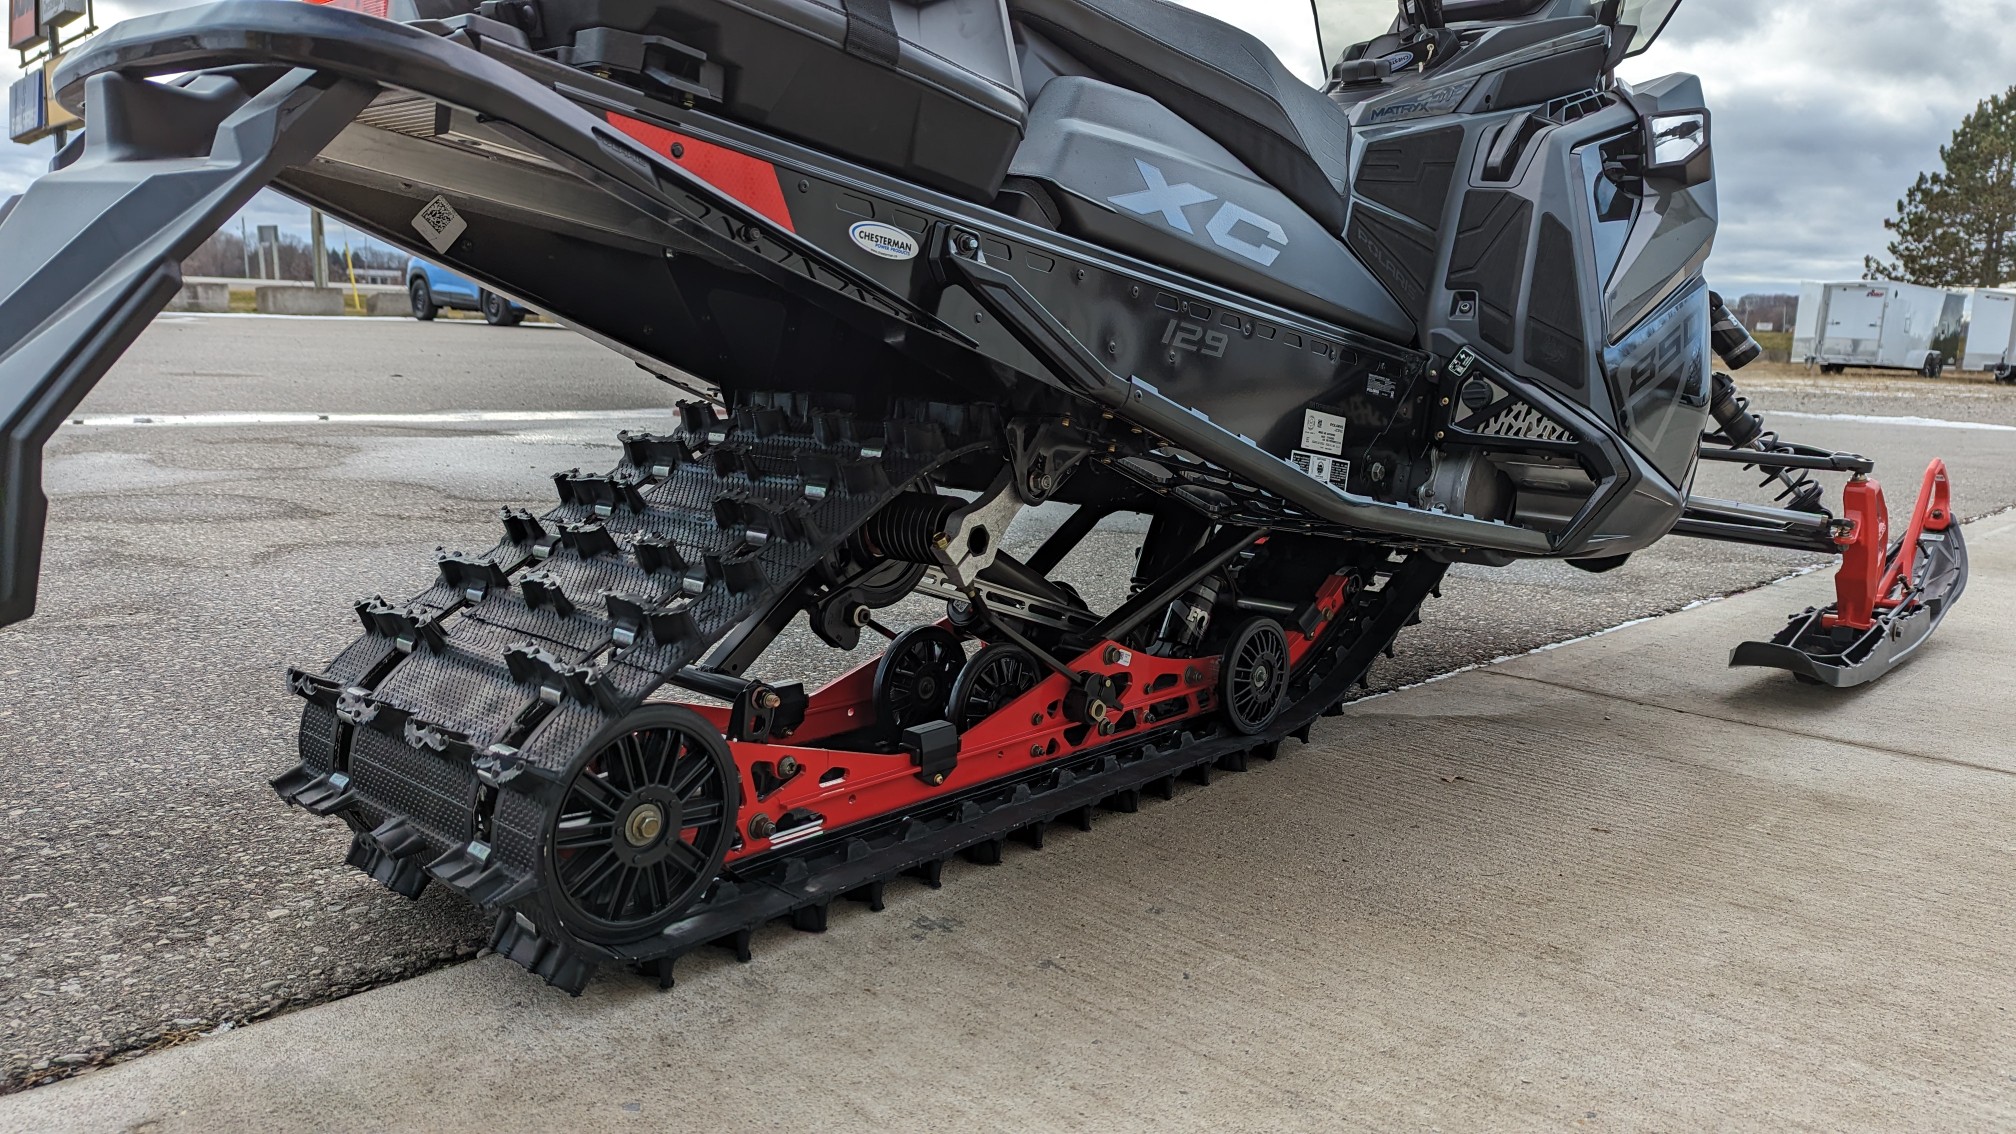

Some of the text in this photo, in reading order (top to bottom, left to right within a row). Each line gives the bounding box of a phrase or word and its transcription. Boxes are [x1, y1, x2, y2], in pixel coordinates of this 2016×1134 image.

[1371, 101, 1430, 120] MATRYX
[1107, 157, 1289, 267] XC
[858, 230, 912, 252] CHESTERMAN
[874, 242, 911, 256] POWER PRODUCTS
[1357, 226, 1419, 301] POLARIS
[1161, 319, 1229, 358] 129
[1186, 605, 1209, 637] FO
